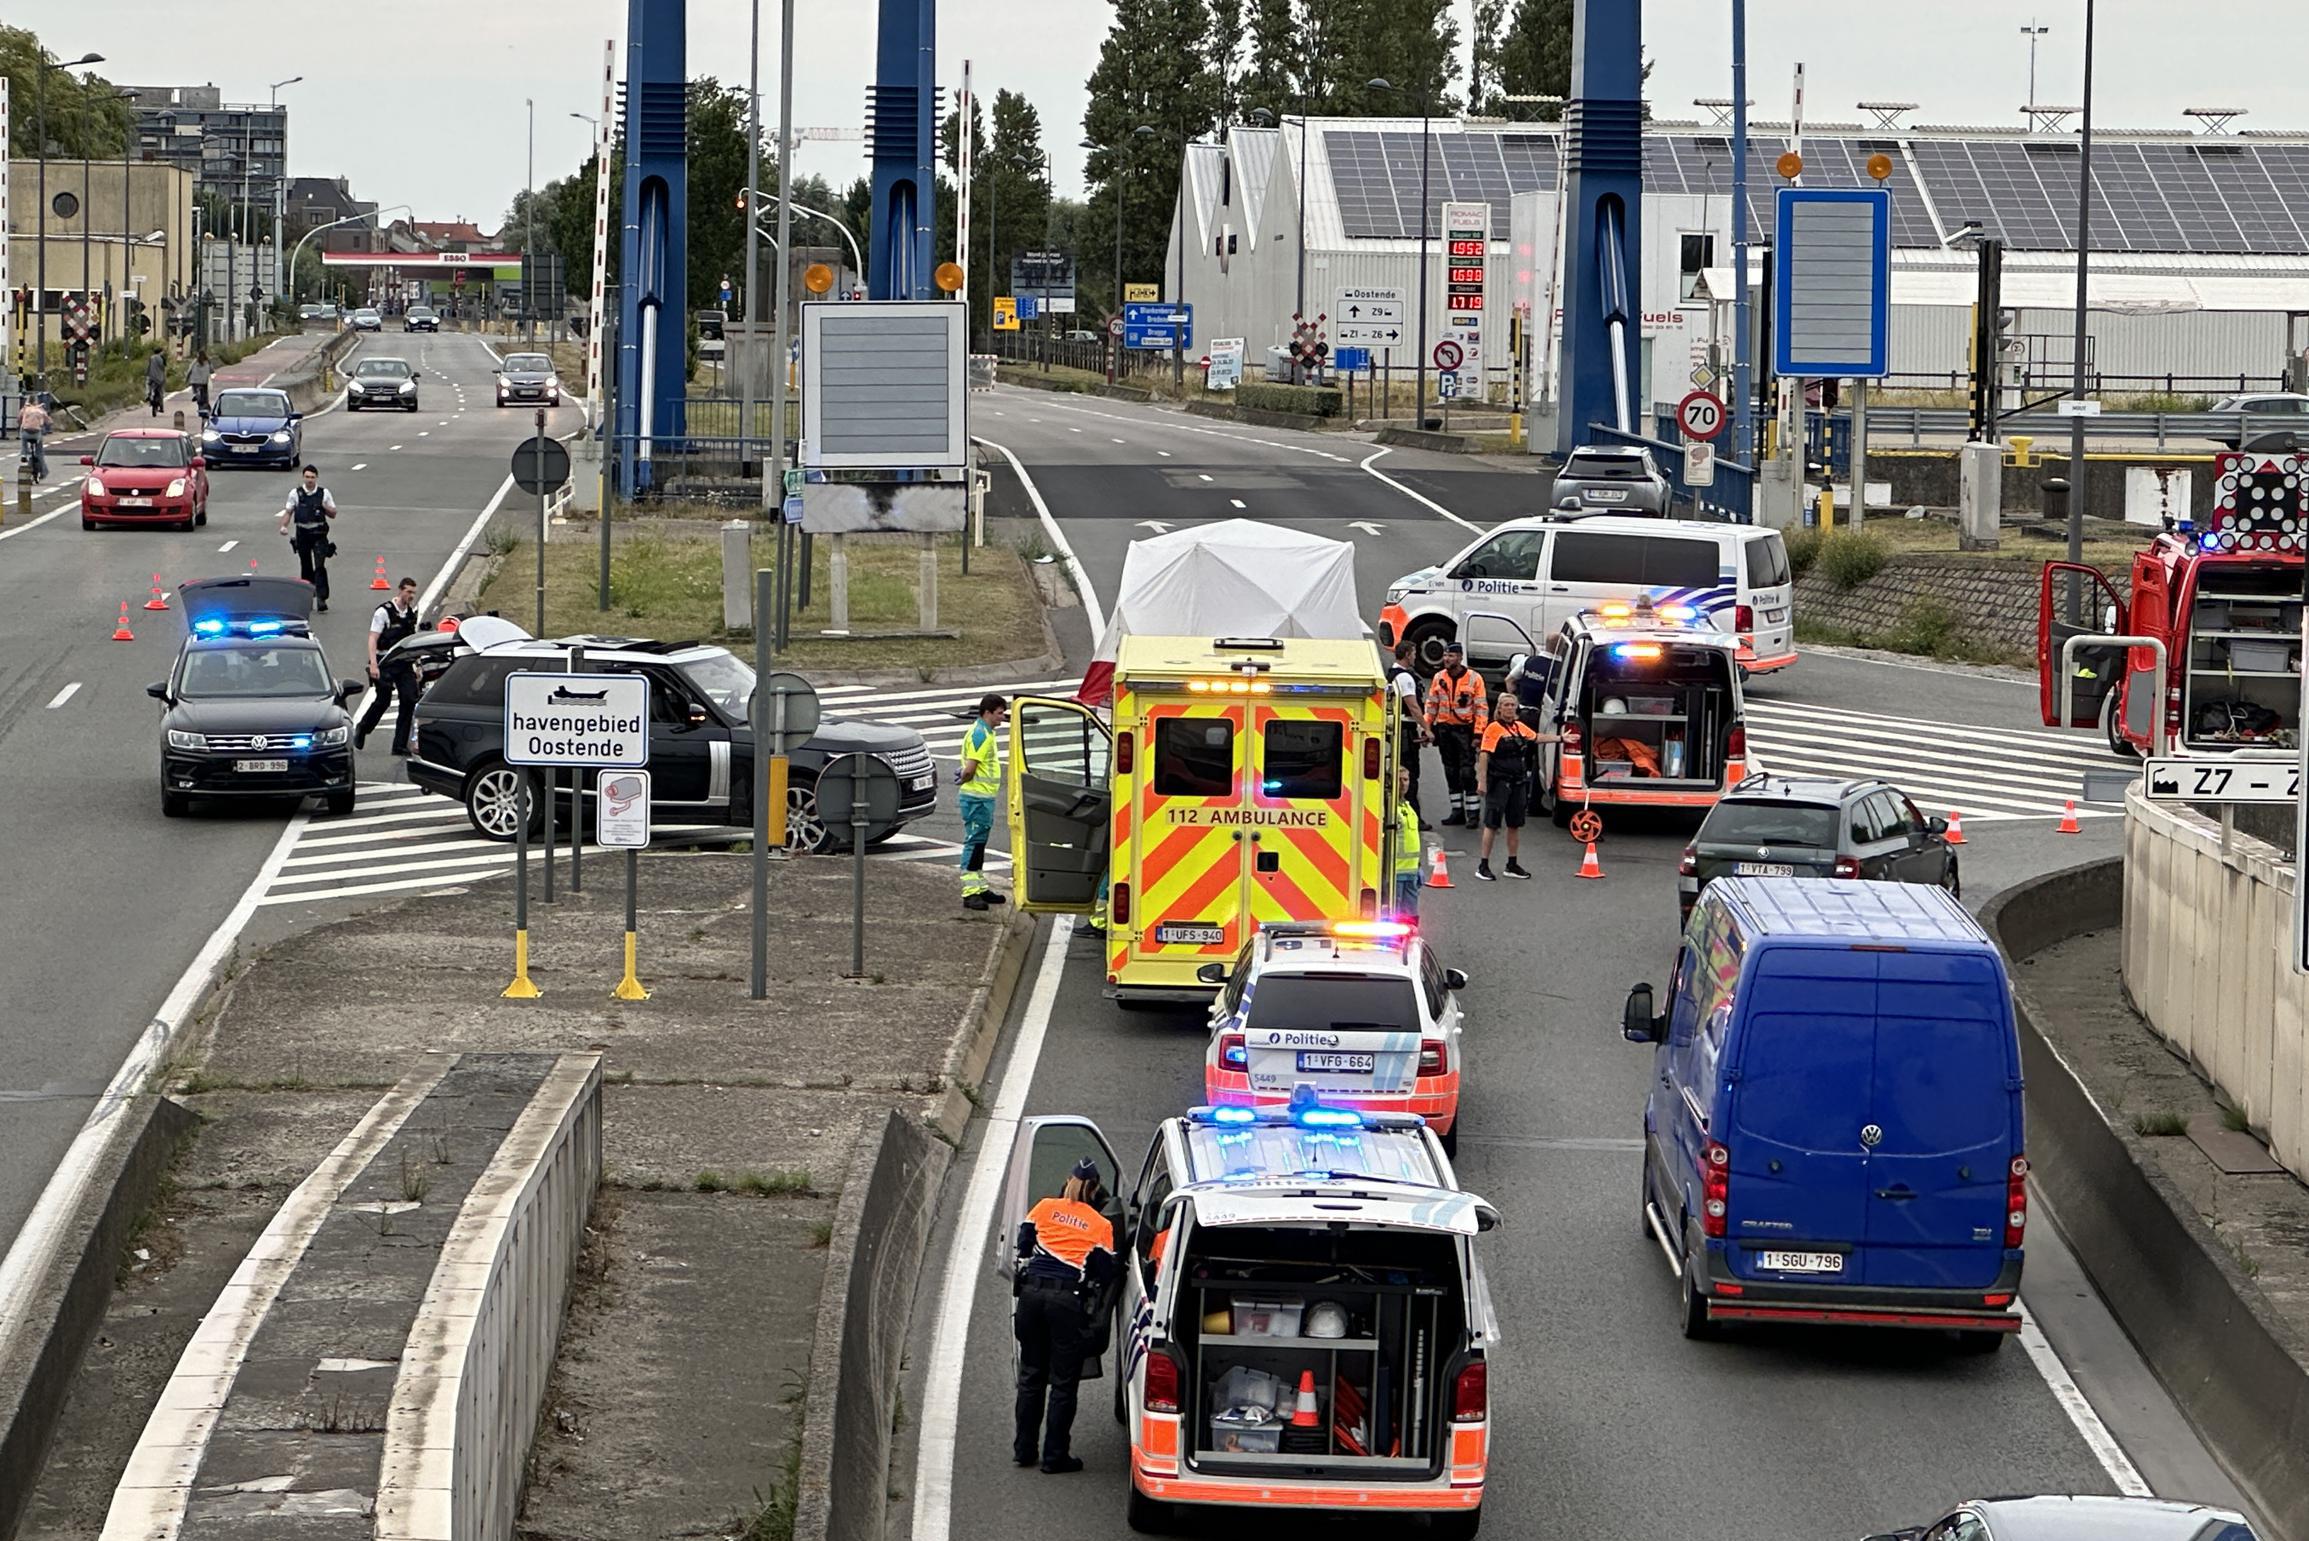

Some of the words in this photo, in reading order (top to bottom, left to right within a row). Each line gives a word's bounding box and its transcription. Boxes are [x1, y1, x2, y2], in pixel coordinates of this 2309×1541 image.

[443, 254, 467, 262] ESSO
[1354, 289, 1396, 299] Oostende
[1371, 307, 1384, 316] Z9
[1641, 311, 1684, 323] uels
[1112, 323, 1123, 331] 70
[1349, 329, 1359, 338] Z1
[1371, 330, 1383, 339] Z6
[1441, 374, 1455, 393] P
[1688, 406, 1716, 425] 70
[1478, 580, 1519, 594] Politie
[1524, 670, 1545, 681] Politie
[513, 712, 640, 736] havengebied
[528, 736, 623, 757] Oostende
[2193, 767, 2233, 795] Z7
[1167, 809, 1198, 823] 112
[1210, 809, 1327, 826] AMBULANCE
[1285, 1033, 1329, 1046] Politie
[1254, 1073, 1277, 1083] 5449
[1052, 1210, 1089, 1231] Politie
